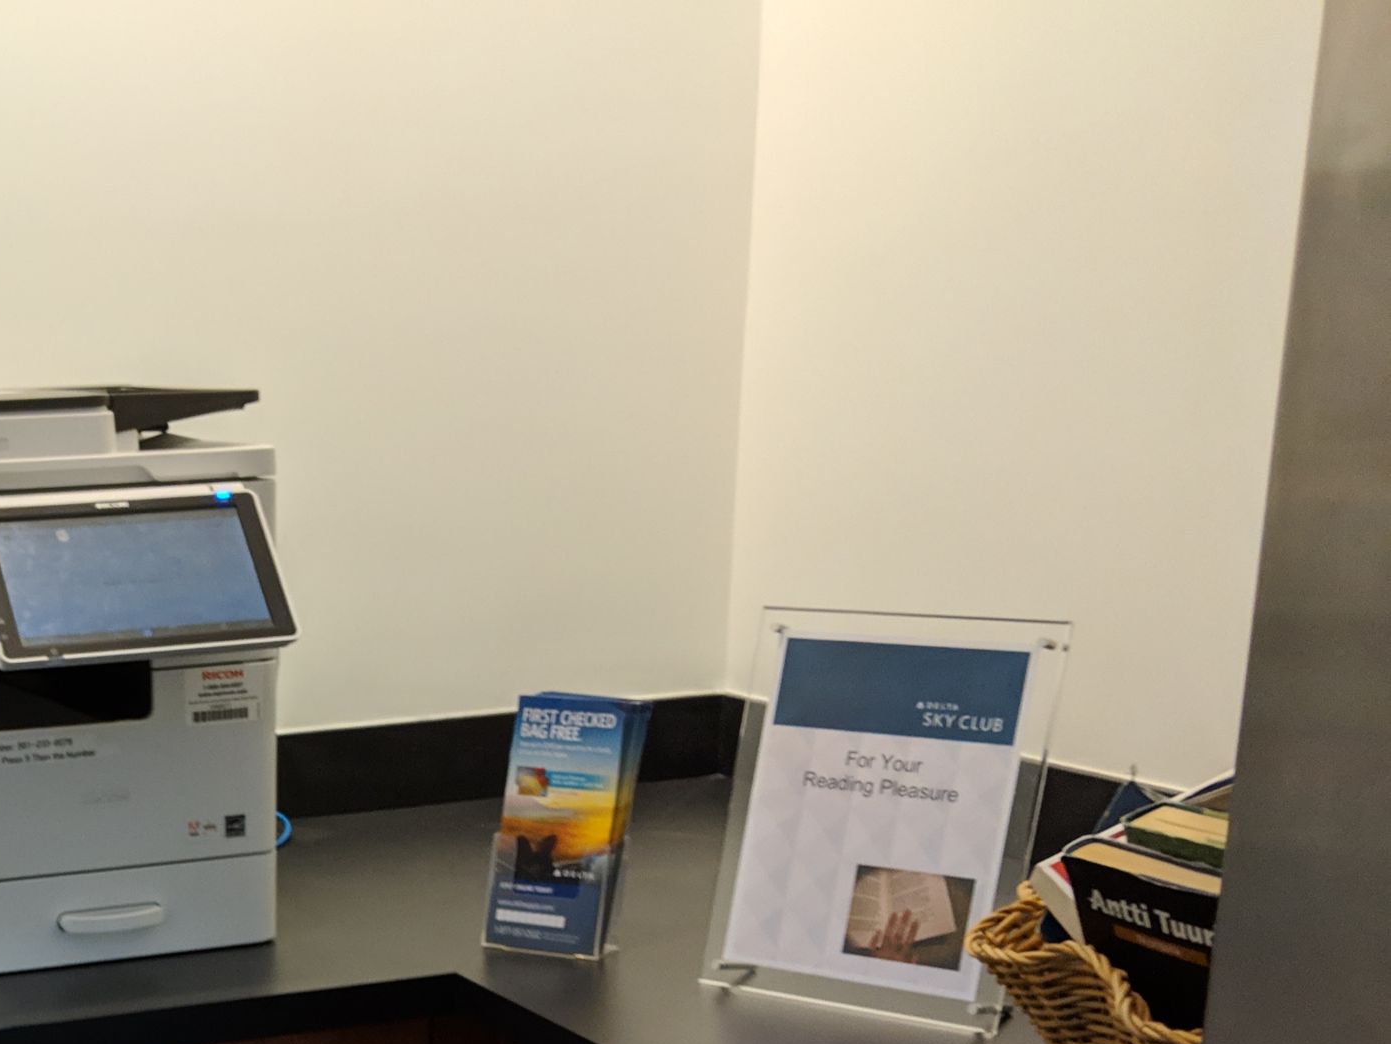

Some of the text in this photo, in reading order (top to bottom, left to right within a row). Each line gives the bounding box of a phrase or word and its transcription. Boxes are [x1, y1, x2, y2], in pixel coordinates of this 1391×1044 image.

[201, 669, 244, 681] RICOH
[925, 701, 960, 711] DELTA
[521, 707, 618, 729] FIRST CHECKED
[922, 712, 1005, 733] SKY CLUB
[520, 722, 549, 739] BAG
[844, 750, 924, 775] For Your
[802, 771, 960, 803] Reading Pleasure
[1088, 888, 1152, 929] Antti
